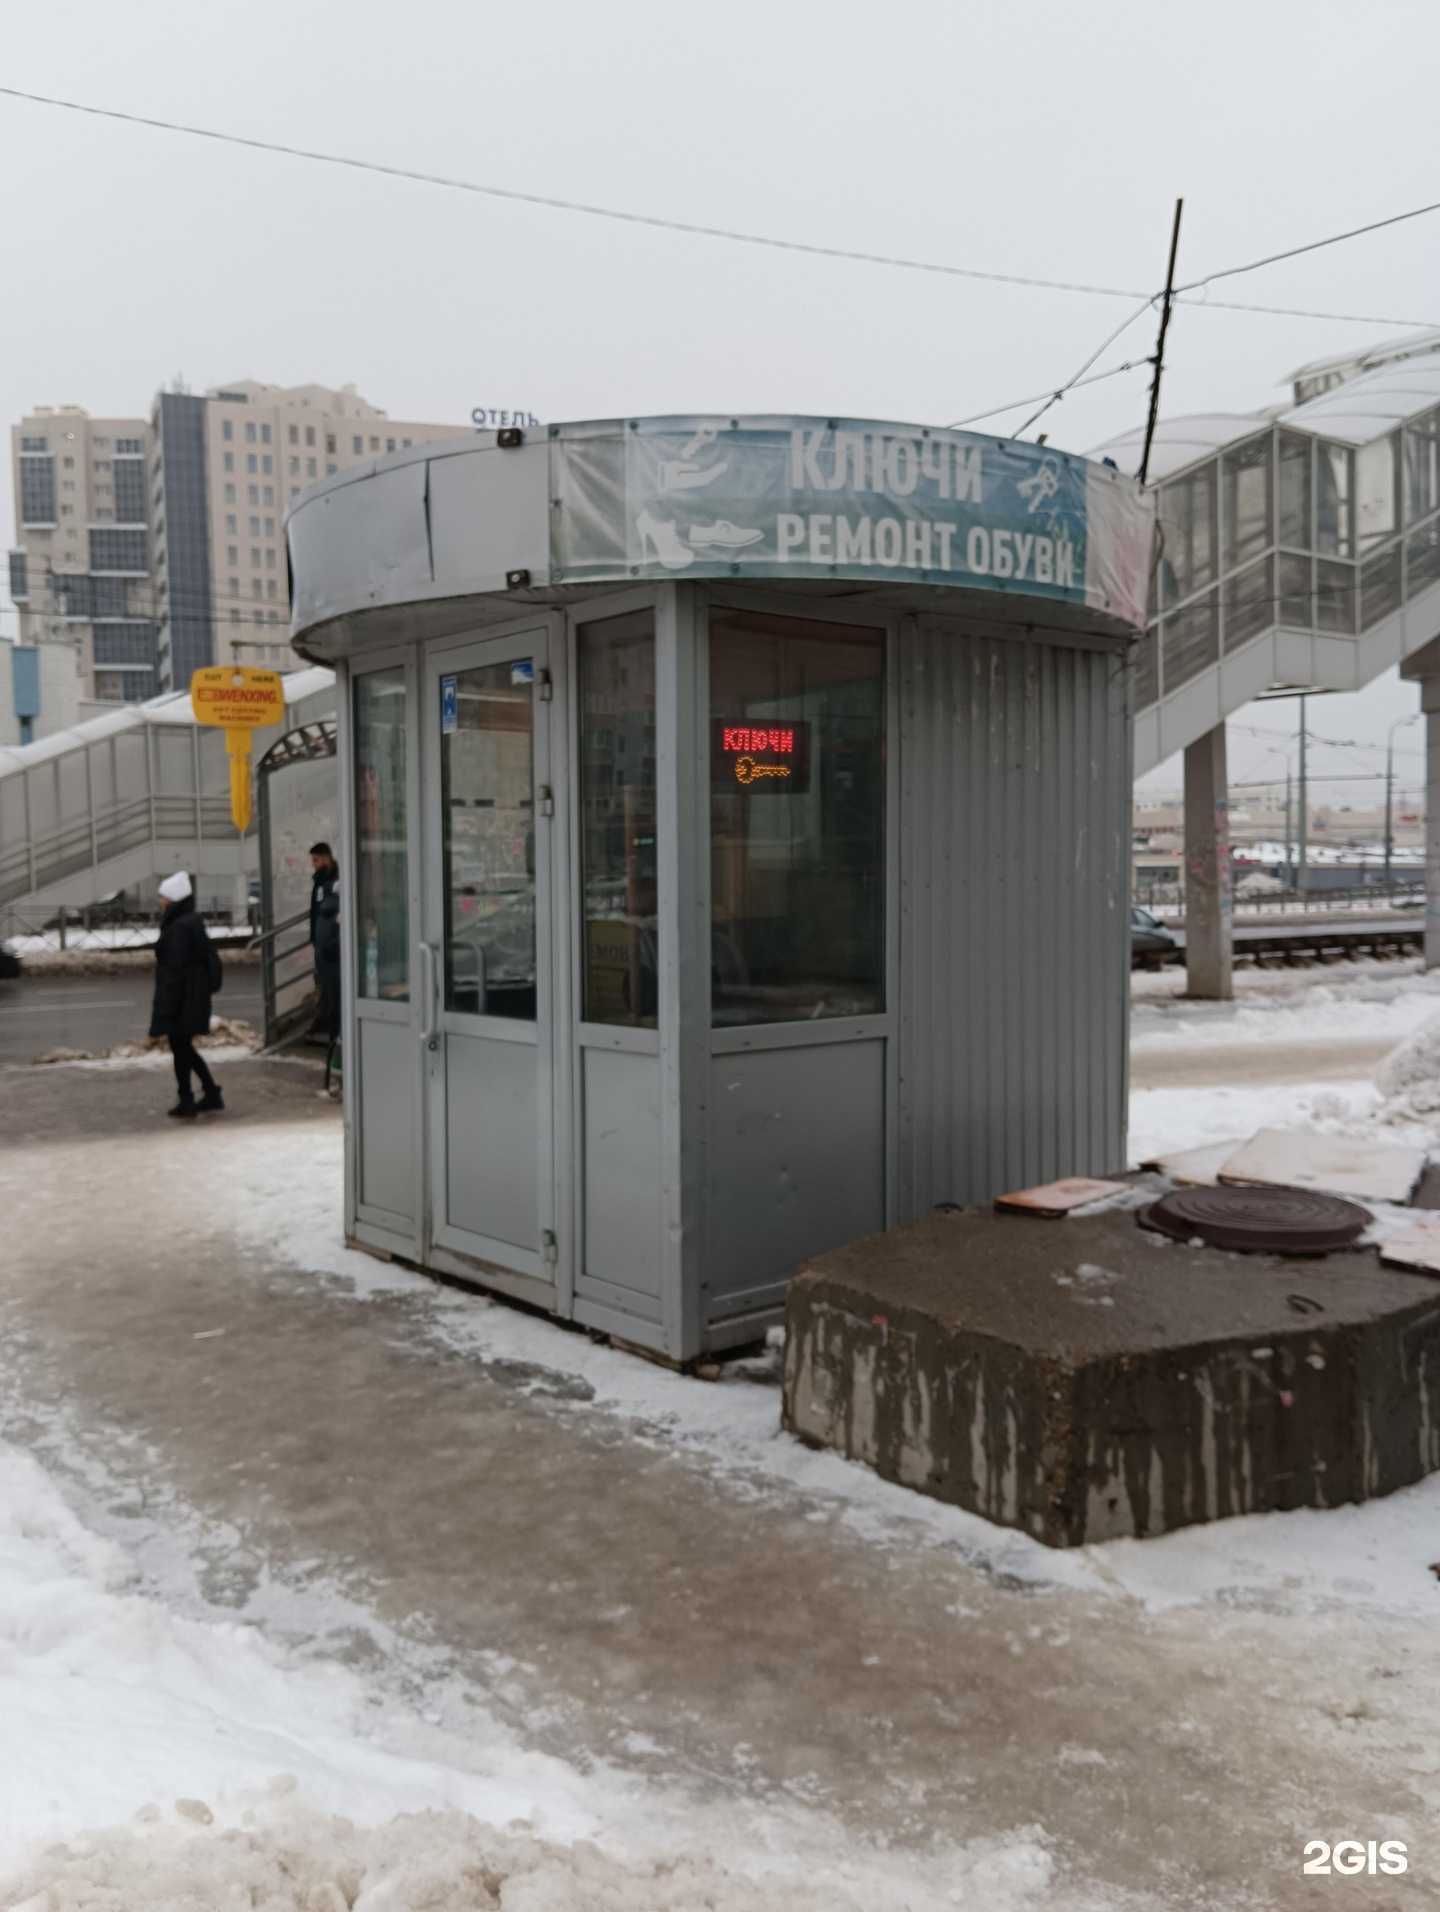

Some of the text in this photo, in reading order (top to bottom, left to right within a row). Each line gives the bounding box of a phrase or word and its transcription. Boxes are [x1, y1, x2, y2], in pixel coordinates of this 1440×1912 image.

[471, 407, 539, 427] ОТЕЛЬ
[790, 430, 982, 502] КЛЮЧИ
[776, 513, 1075, 587] РЕМОНТ ОБУВИ
[722, 728, 794, 752] КЛЮЧИ
